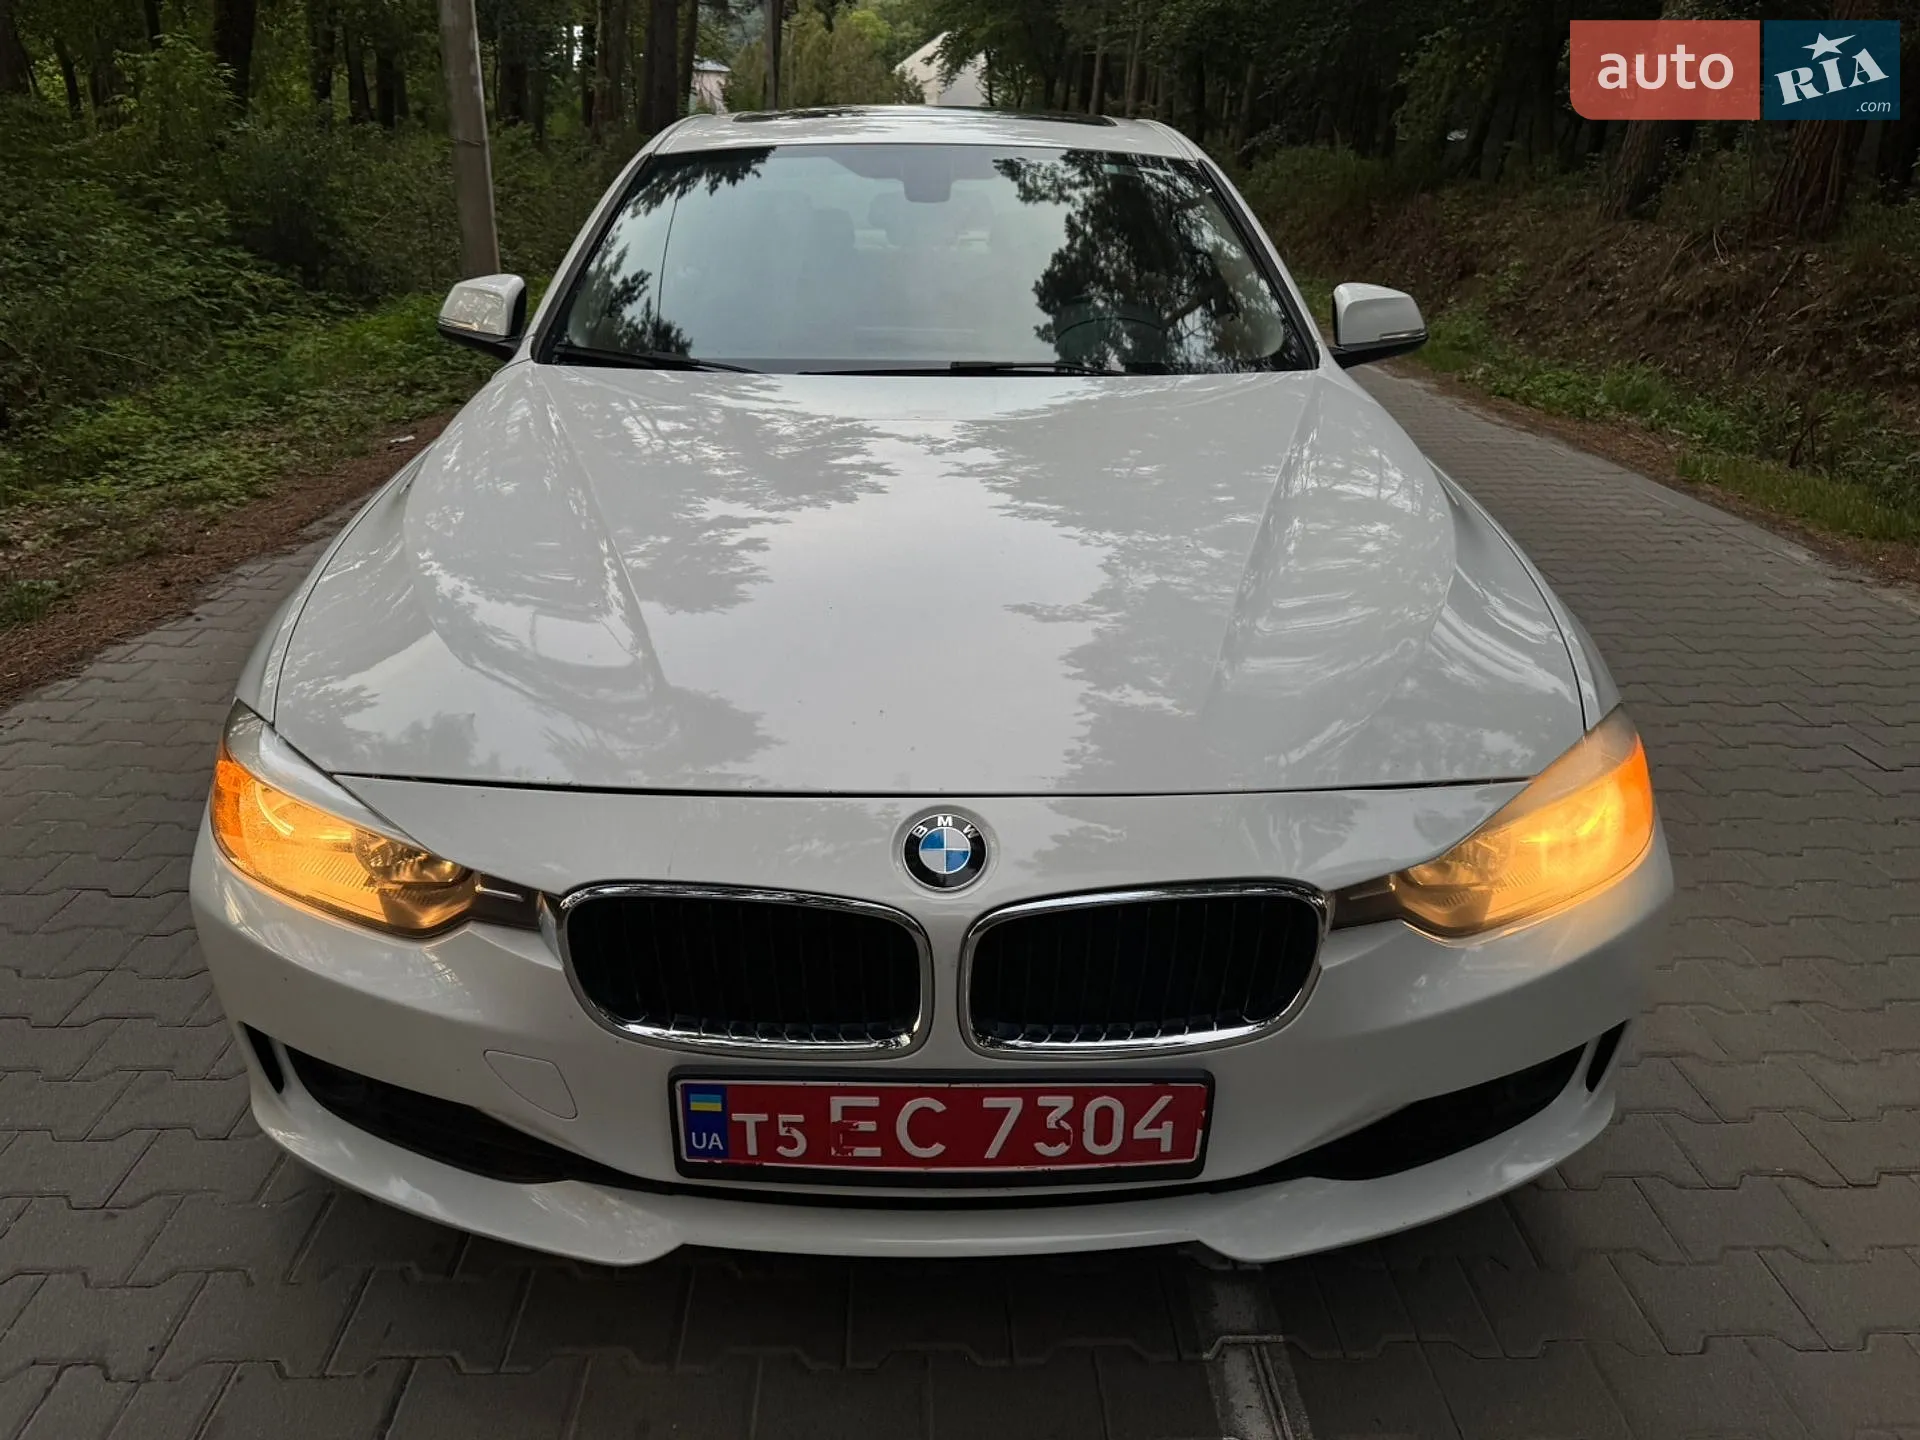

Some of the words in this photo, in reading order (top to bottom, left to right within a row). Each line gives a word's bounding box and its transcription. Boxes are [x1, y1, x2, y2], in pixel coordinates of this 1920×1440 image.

[912, 815, 980, 839] BMW
[732, 1113, 807, 1157] T5
[830, 1096, 946, 1158] EC
[982, 1095, 1174, 1159] 7304
[691, 1132, 723, 1151] UA
